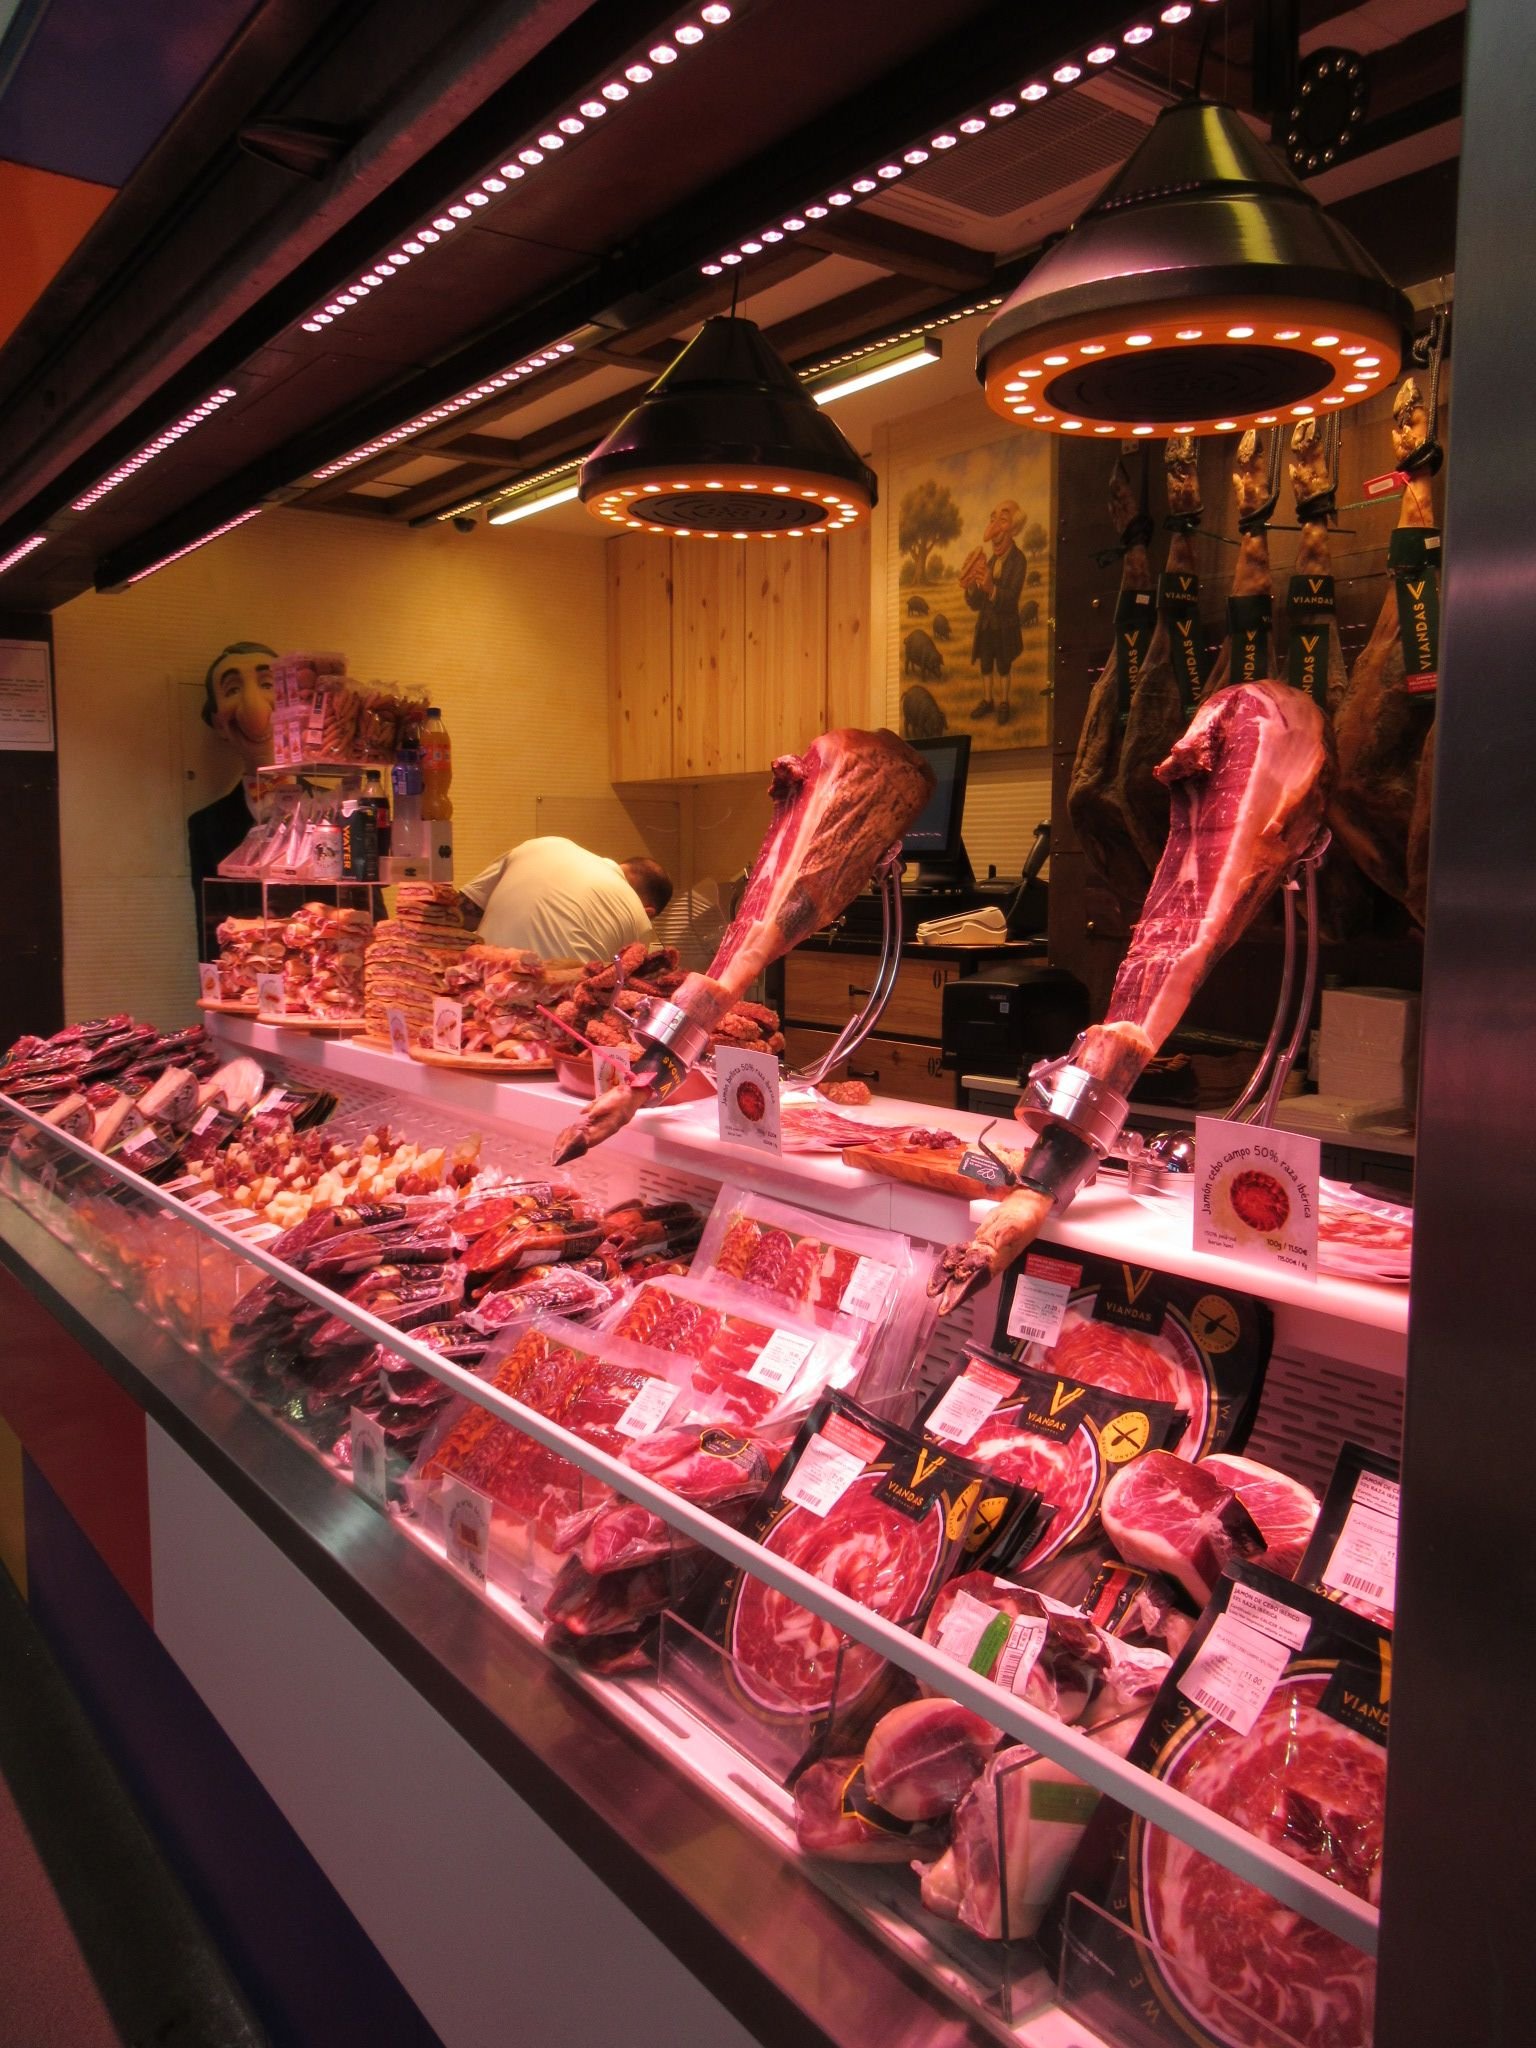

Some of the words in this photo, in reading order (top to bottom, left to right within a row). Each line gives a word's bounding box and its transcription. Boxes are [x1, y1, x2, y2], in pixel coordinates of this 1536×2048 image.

[1293, 596, 1334, 605] VIANDAS
[1413, 602, 1432, 671] VIANDAS
[1183, 640, 1201, 700] VIANDAS
[1244, 645, 1256, 680] NDAS
[1303, 655, 1315, 697] NDAS
[343, 825, 351, 869] WATER
[927, 1056, 943, 1078] 02
[1201, 1183, 1213, 1215] Jamón
[1209, 1161, 1223, 1181] cebo
[1223, 1147, 1250, 1163] campo
[1254, 1145, 1279, 1164] 50%
[1281, 1161, 1298, 1182] raza
[1297, 1182, 1311, 1218] ibérica
[1266, 1238, 1283, 1251] 100g
[1105, 1301, 1153, 1322] VIANDAS
[1026, 1411, 1067, 1432] VIANDAS
[887, 1481, 924, 1508] VIANDAS
[1342, 1690, 1390, 1726] VIAND
